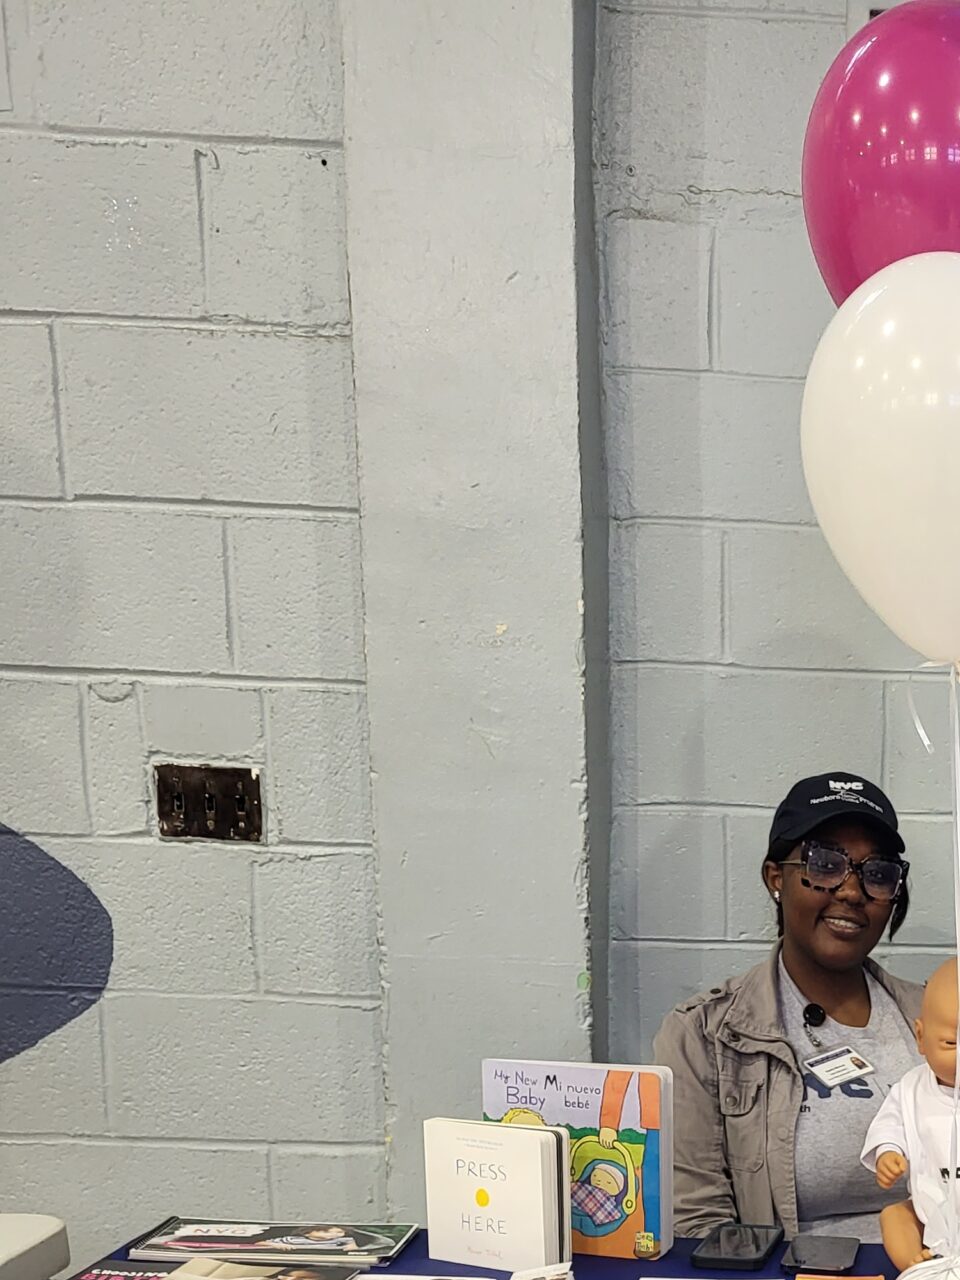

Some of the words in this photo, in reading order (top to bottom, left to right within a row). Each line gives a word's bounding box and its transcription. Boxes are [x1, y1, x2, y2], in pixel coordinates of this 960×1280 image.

[829, 780, 864, 790] NYC
[493, 1069, 510, 1080] My
[515, 1071, 538, 1087] New
[543, 1074, 563, 1092] Mi
[566, 1084, 601, 1096] nuevo
[506, 1086, 546, 1111] Baby
[564, 1099, 590, 1110] bebé
[455, 1158, 508, 1182] PRESS
[461, 1212, 508, 1236] HERE
